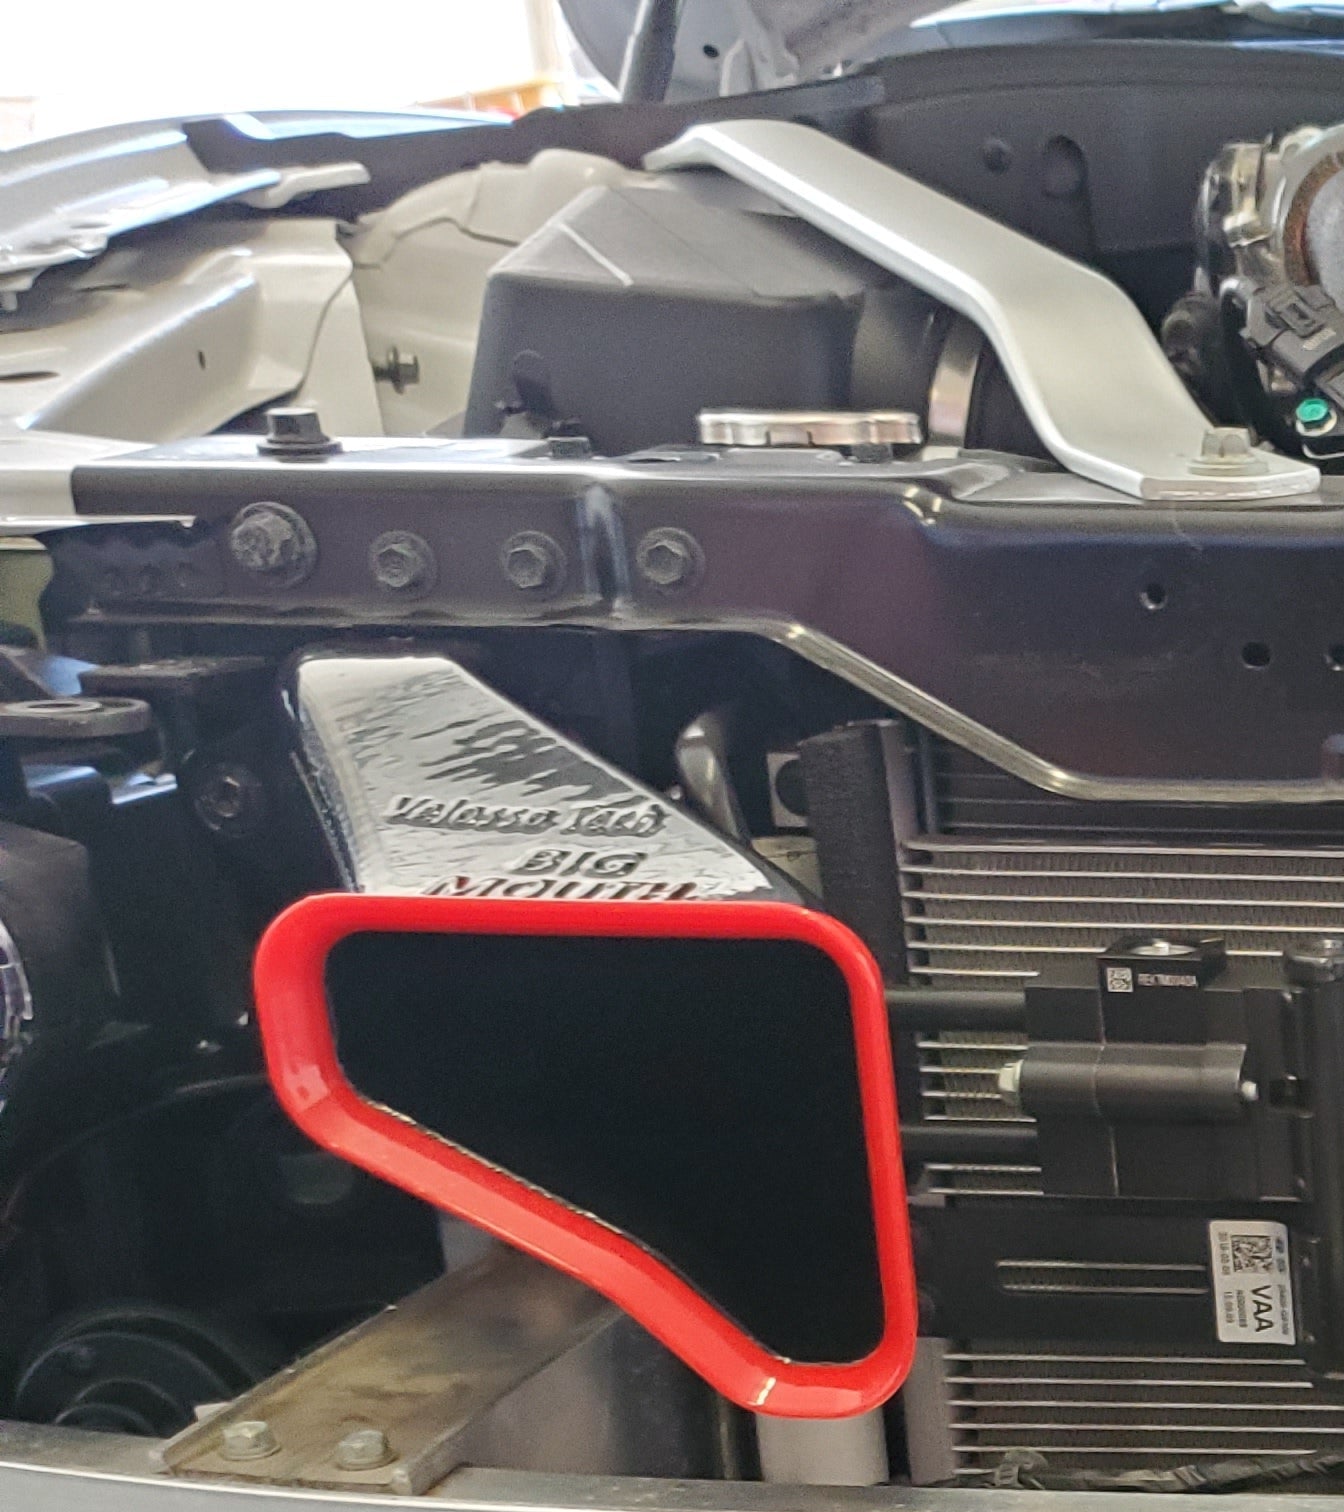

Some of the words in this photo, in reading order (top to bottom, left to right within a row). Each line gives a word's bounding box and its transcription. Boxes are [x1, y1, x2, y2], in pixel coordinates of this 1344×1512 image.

[561, 800, 672, 837] Tech
[506, 849, 648, 878] BIG
[421, 875, 700, 901] MOUTH
[1251, 1285, 1274, 1333] VAA
